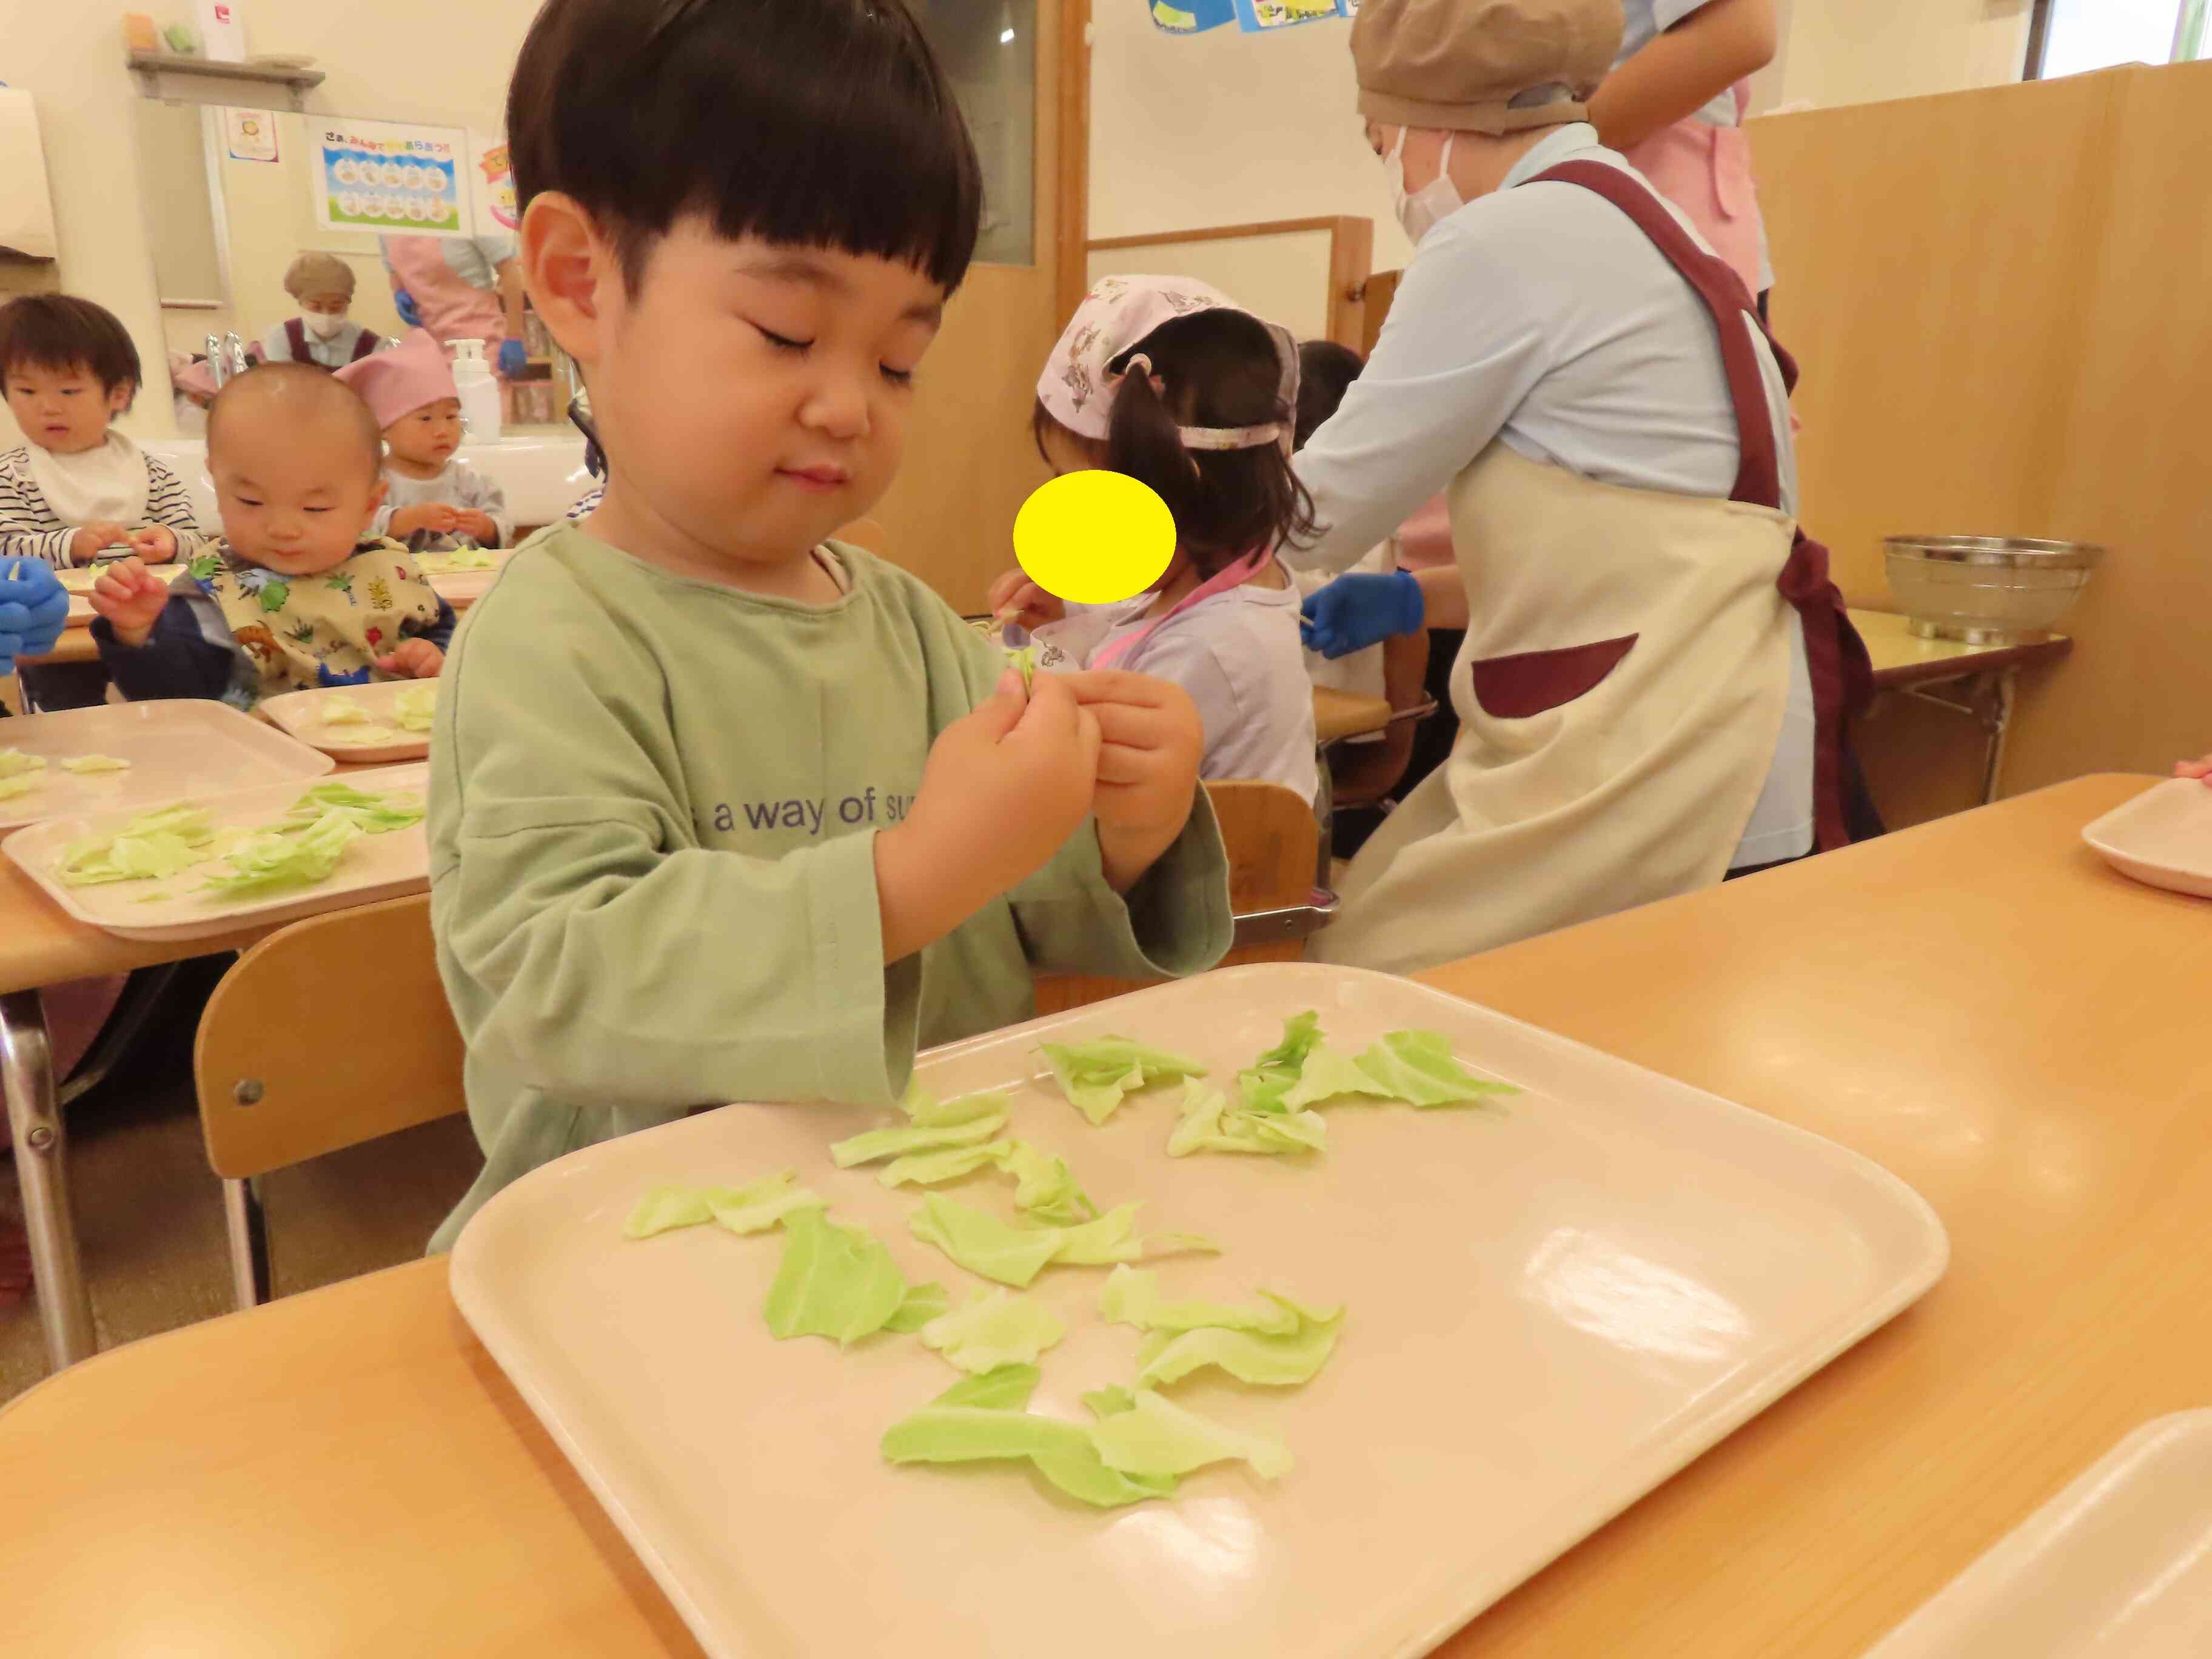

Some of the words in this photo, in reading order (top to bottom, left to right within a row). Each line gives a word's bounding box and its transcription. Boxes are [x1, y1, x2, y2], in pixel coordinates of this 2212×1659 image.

[714, 803, 734, 832] a
[743, 797, 825, 835] way
[839, 787, 876, 823] of
